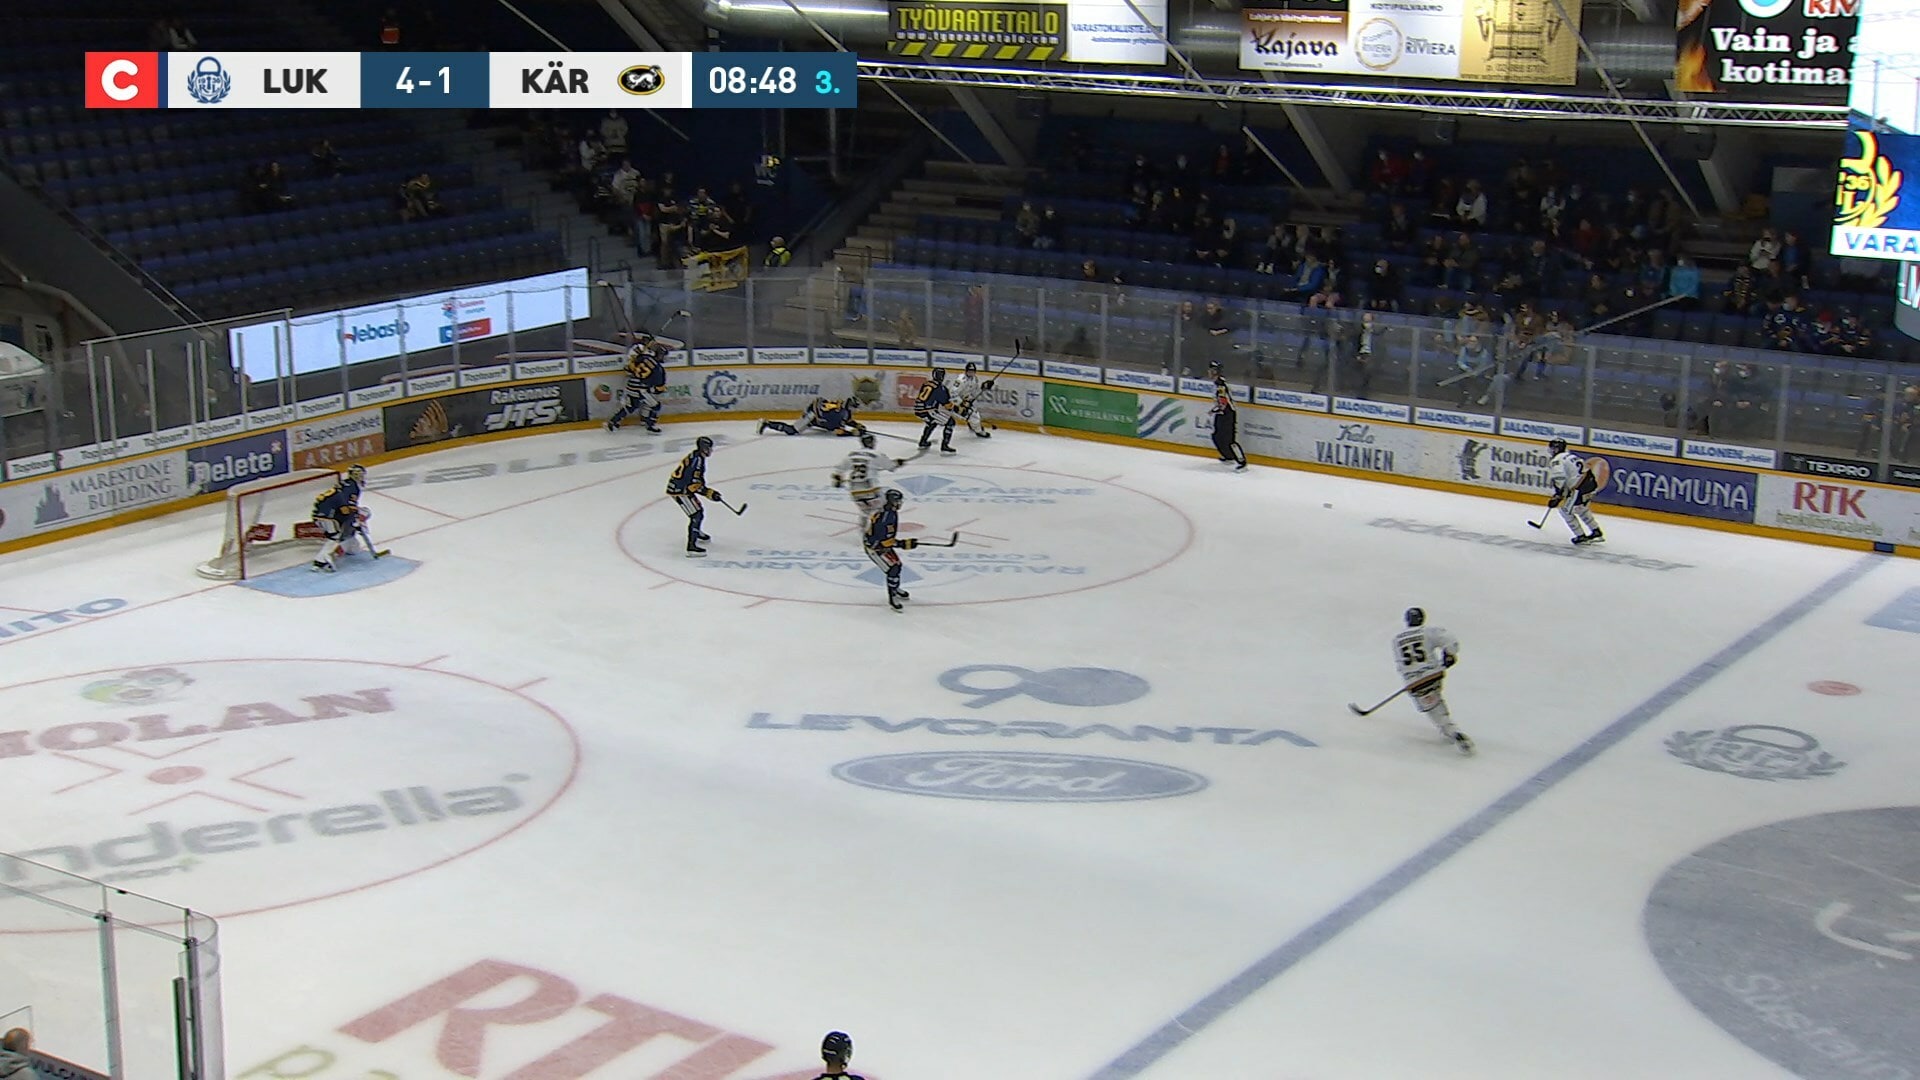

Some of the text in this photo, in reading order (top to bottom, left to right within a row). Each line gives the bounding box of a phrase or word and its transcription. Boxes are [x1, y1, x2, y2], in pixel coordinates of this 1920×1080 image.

[1711, 27, 1791, 52] Vain
[1797, 28, 1839, 59] ja
[490, 386, 561, 405] Rakennus
[483, 399, 565, 431] JTS
[305, 439, 374, 468] ARENA
[1316, 440, 1394, 472] VALTANEN
[1806, 460, 1871, 478] TEXPRO
[70, 459, 172, 495] MARESTONE
[1613, 468, 1748, 512] SATAMUNA
[88, 478, 171, 510] BUILDING
[1794, 482, 1867, 518] RTK
[1402, 641, 1425, 666] 55
[745, 712, 1319, 748] LEVORANTA
[904, 756, 1123, 794] Ford
